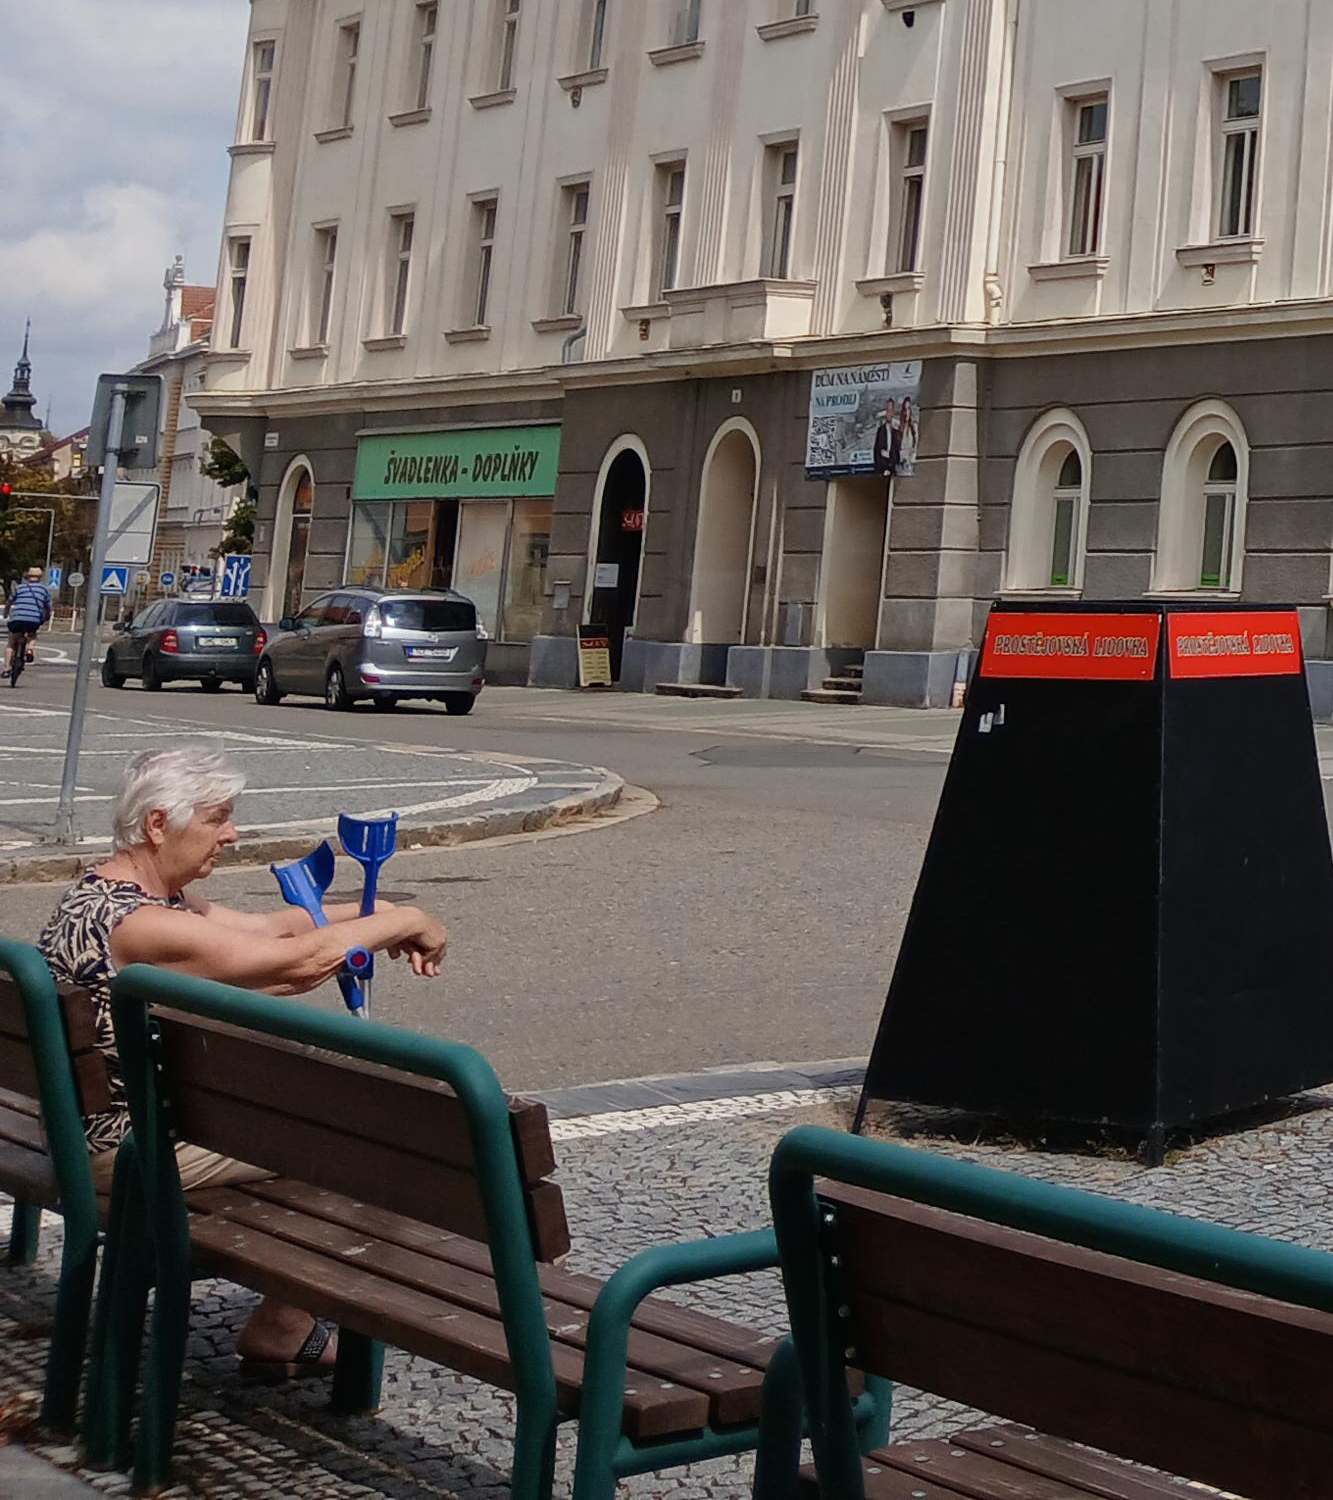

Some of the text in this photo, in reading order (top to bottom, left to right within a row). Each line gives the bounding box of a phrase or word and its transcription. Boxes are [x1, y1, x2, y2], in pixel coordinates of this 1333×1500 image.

[384, 450, 460, 485] ŠVADLENKA
[472, 444, 540, 483] DOPLŇKY
[993, 631, 1149, 658] PROSTĚJOVSKÁ LIDOVKA
